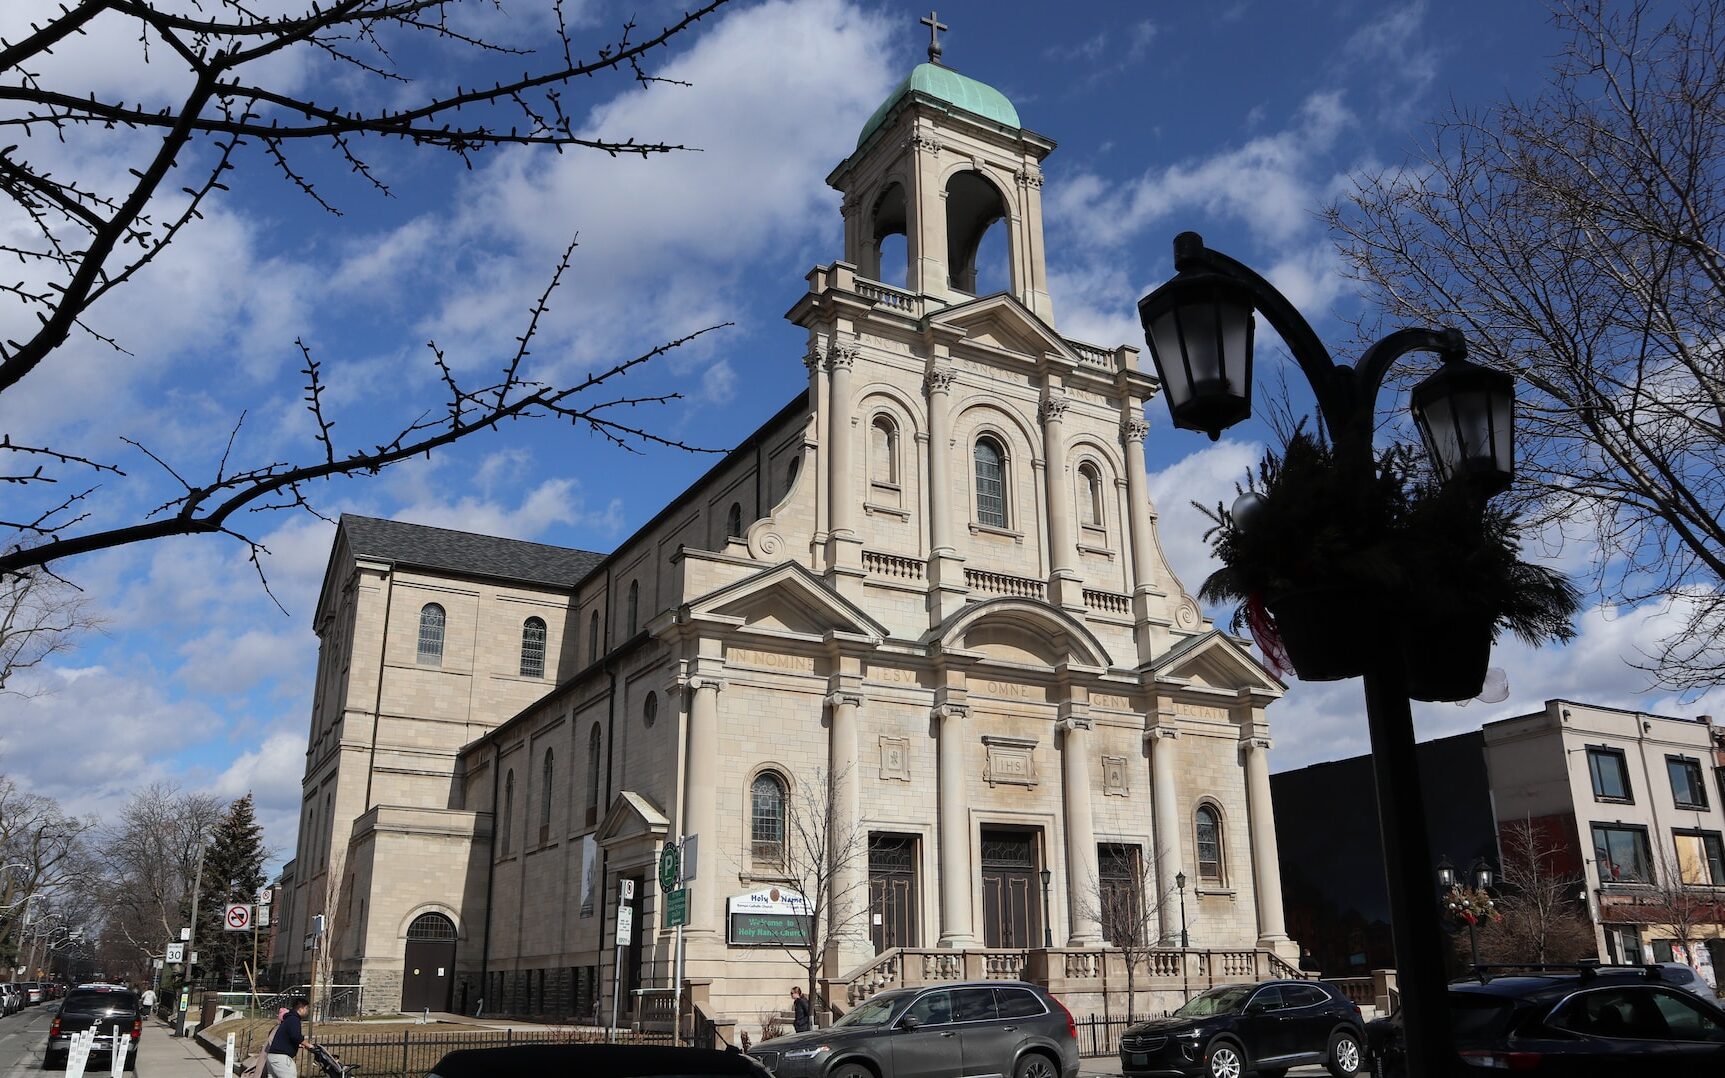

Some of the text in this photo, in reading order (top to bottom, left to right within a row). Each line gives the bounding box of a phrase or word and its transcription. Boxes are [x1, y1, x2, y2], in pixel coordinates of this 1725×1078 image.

[865, 336, 909, 352] ANCTV
[962, 360, 1020, 382] SANCTVS
[731, 648, 1226, 719] IN NOMINE IESV OMNE GENV LECTATV
[1000, 759, 1021, 771] IHS
[664, 855, 673, 876] P
[751, 895, 768, 904] Holy
[738, 927, 756, 937] Holy
[780, 929, 806, 937] Church
[168, 950, 182, 960] 30
